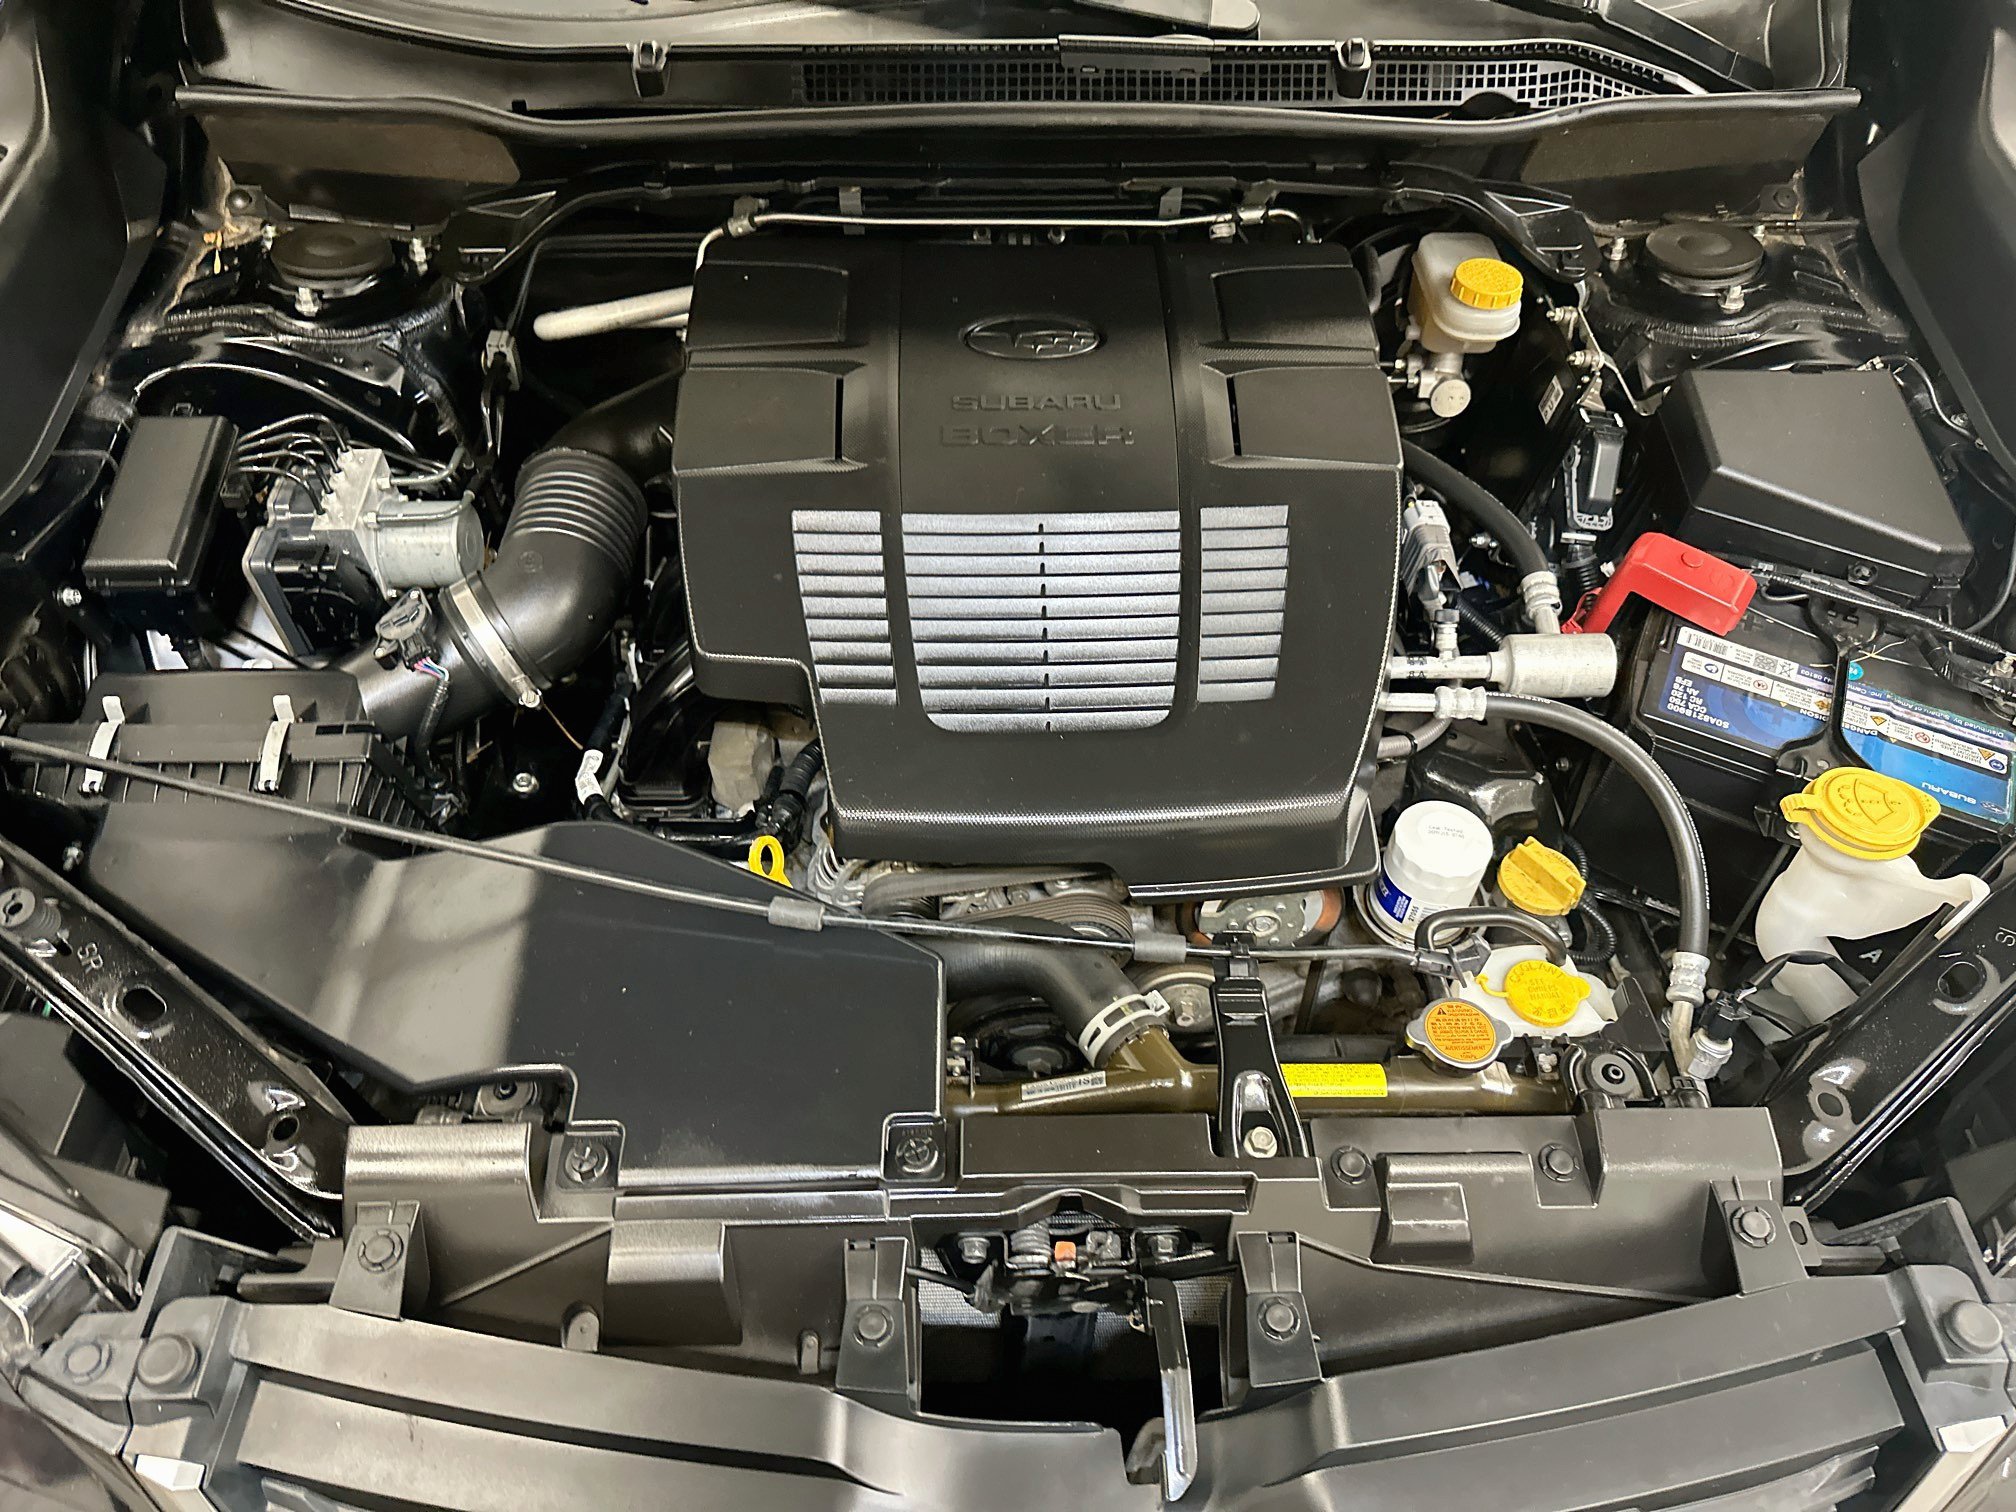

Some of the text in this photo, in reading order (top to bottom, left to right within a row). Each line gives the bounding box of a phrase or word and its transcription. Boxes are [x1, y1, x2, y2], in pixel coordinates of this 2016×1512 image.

[952, 394, 1121, 411] SUBARU
[939, 424, 1135, 447] BOXER
[1671, 689, 1703, 705] RC 120
[1686, 687, 1700, 696] Ah
[1669, 696, 1707, 714] CCA 750
[1800, 708, 1830, 722] OISON
[1923, 708, 1951, 720] Subaru
[1952, 717, 1963, 726] by
[1964, 720, 2004, 738] Distributed
[1921, 781, 1977, 805] SUBARU
[77, 941, 104, 975] SR
